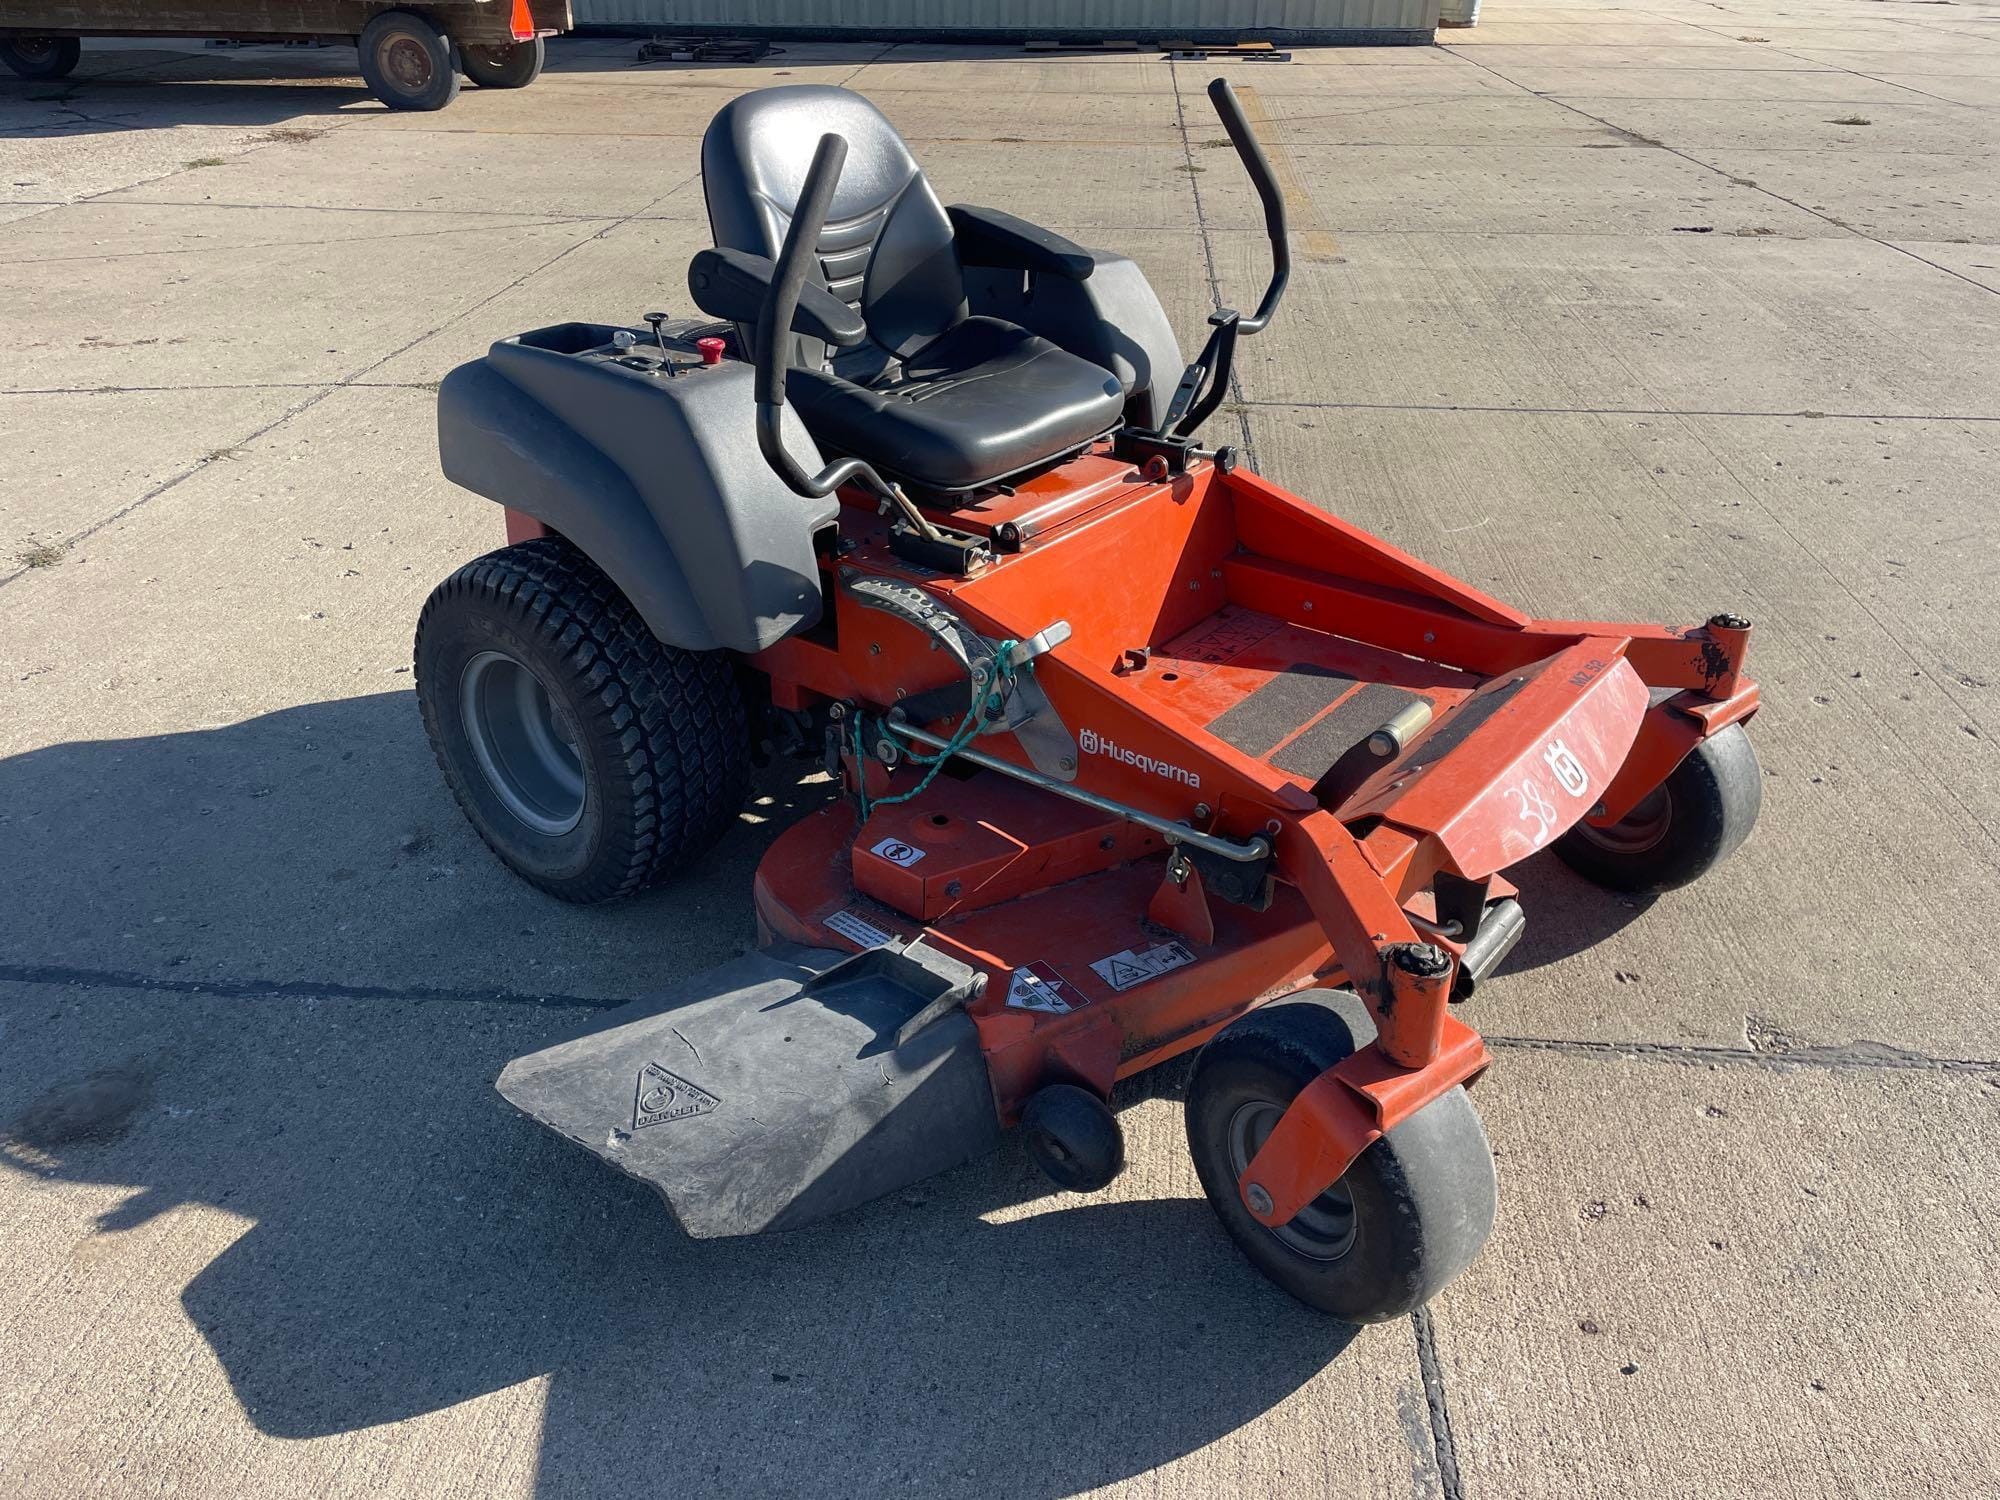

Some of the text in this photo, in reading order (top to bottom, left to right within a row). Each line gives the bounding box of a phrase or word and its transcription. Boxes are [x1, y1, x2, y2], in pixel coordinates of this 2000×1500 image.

[1100, 737, 1200, 789] Husqvarna
[1503, 778, 1558, 846] 38
[638, 1104, 701, 1126] DANGER
